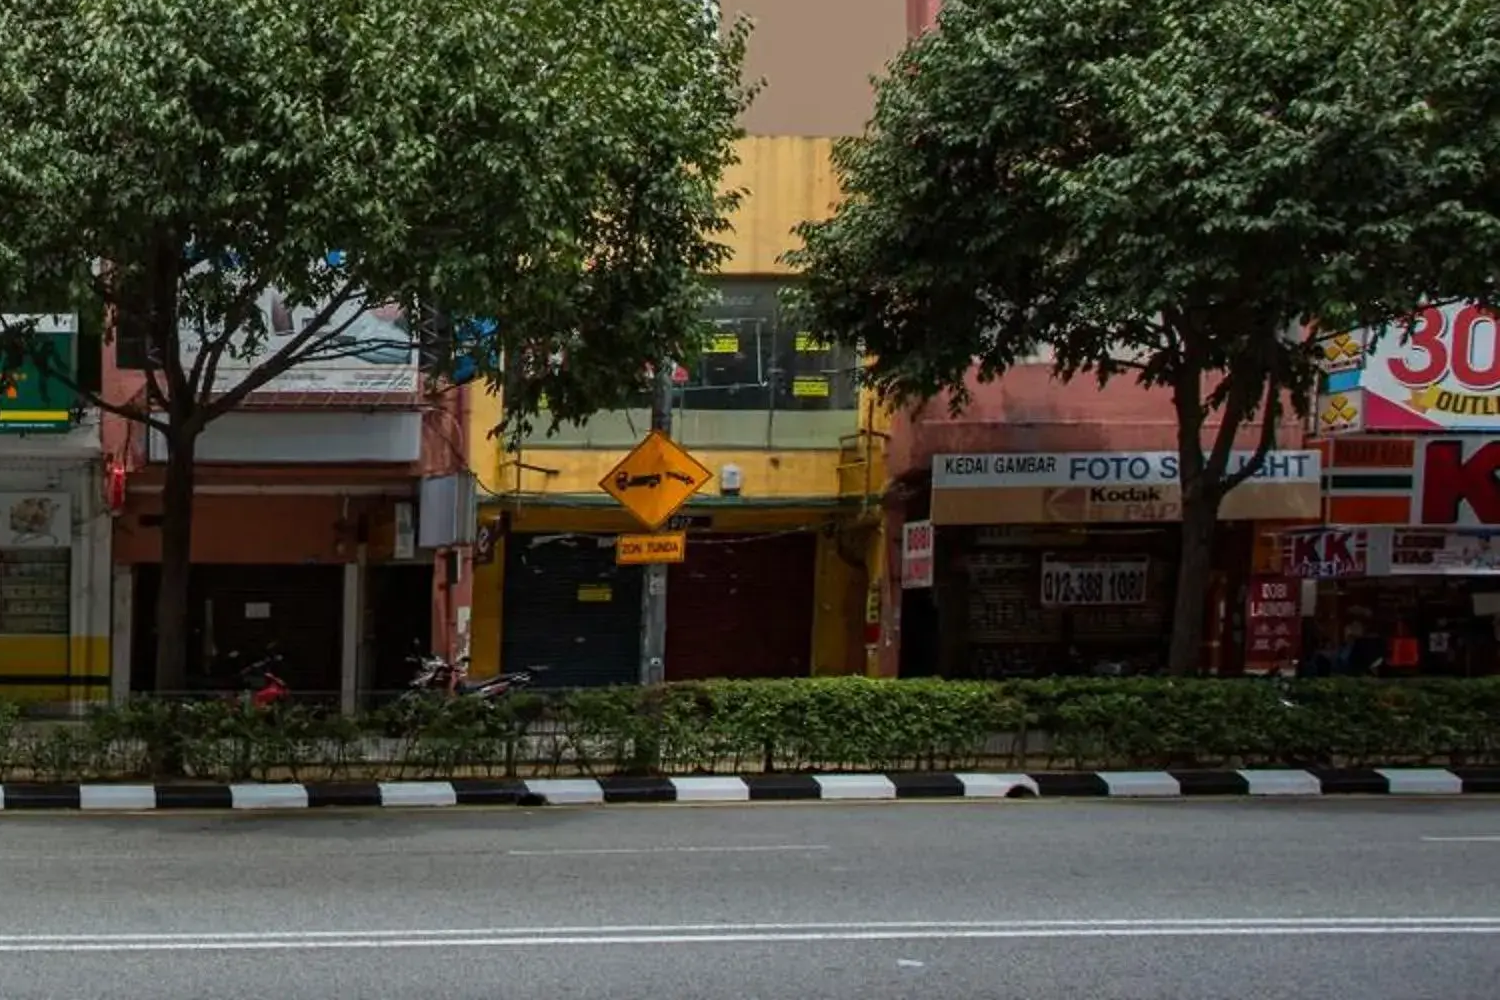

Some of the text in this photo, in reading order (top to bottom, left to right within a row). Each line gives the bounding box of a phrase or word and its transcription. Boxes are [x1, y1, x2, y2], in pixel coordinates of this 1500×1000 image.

[1436, 391, 1500, 414] OUTL
[945, 457, 988, 474] KEDAI
[995, 456, 1056, 474] GAMBAR
[1070, 457, 1149, 480] FOTO
[1090, 487, 1161, 502] Kodak
[621, 541, 679, 555] ZON TUNDA
